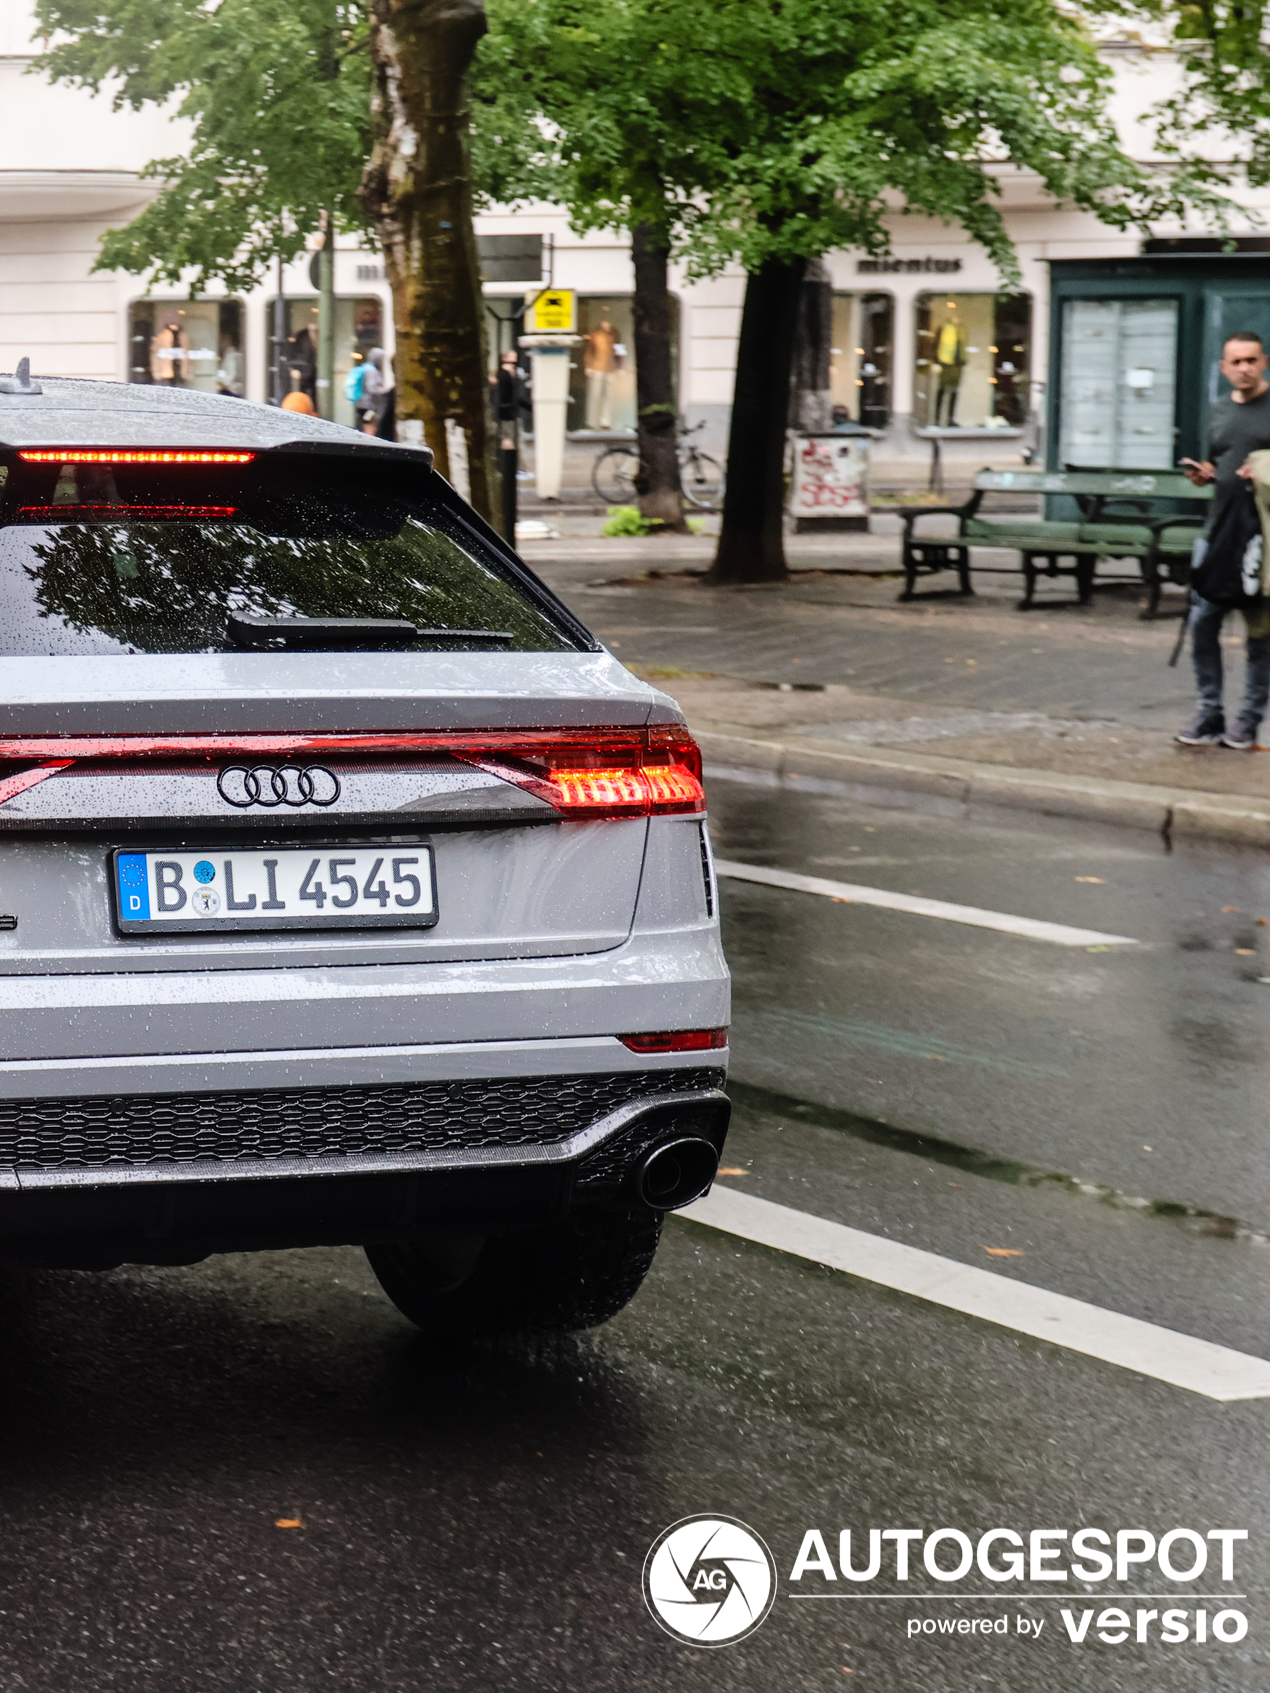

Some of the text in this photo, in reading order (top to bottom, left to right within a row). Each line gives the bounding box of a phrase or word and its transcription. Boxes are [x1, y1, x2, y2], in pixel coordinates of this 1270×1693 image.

[155, 860, 187, 912] B
[224, 858, 286, 911] LI
[299, 857, 421, 908] 4545
[130, 895, 141, 910] D
